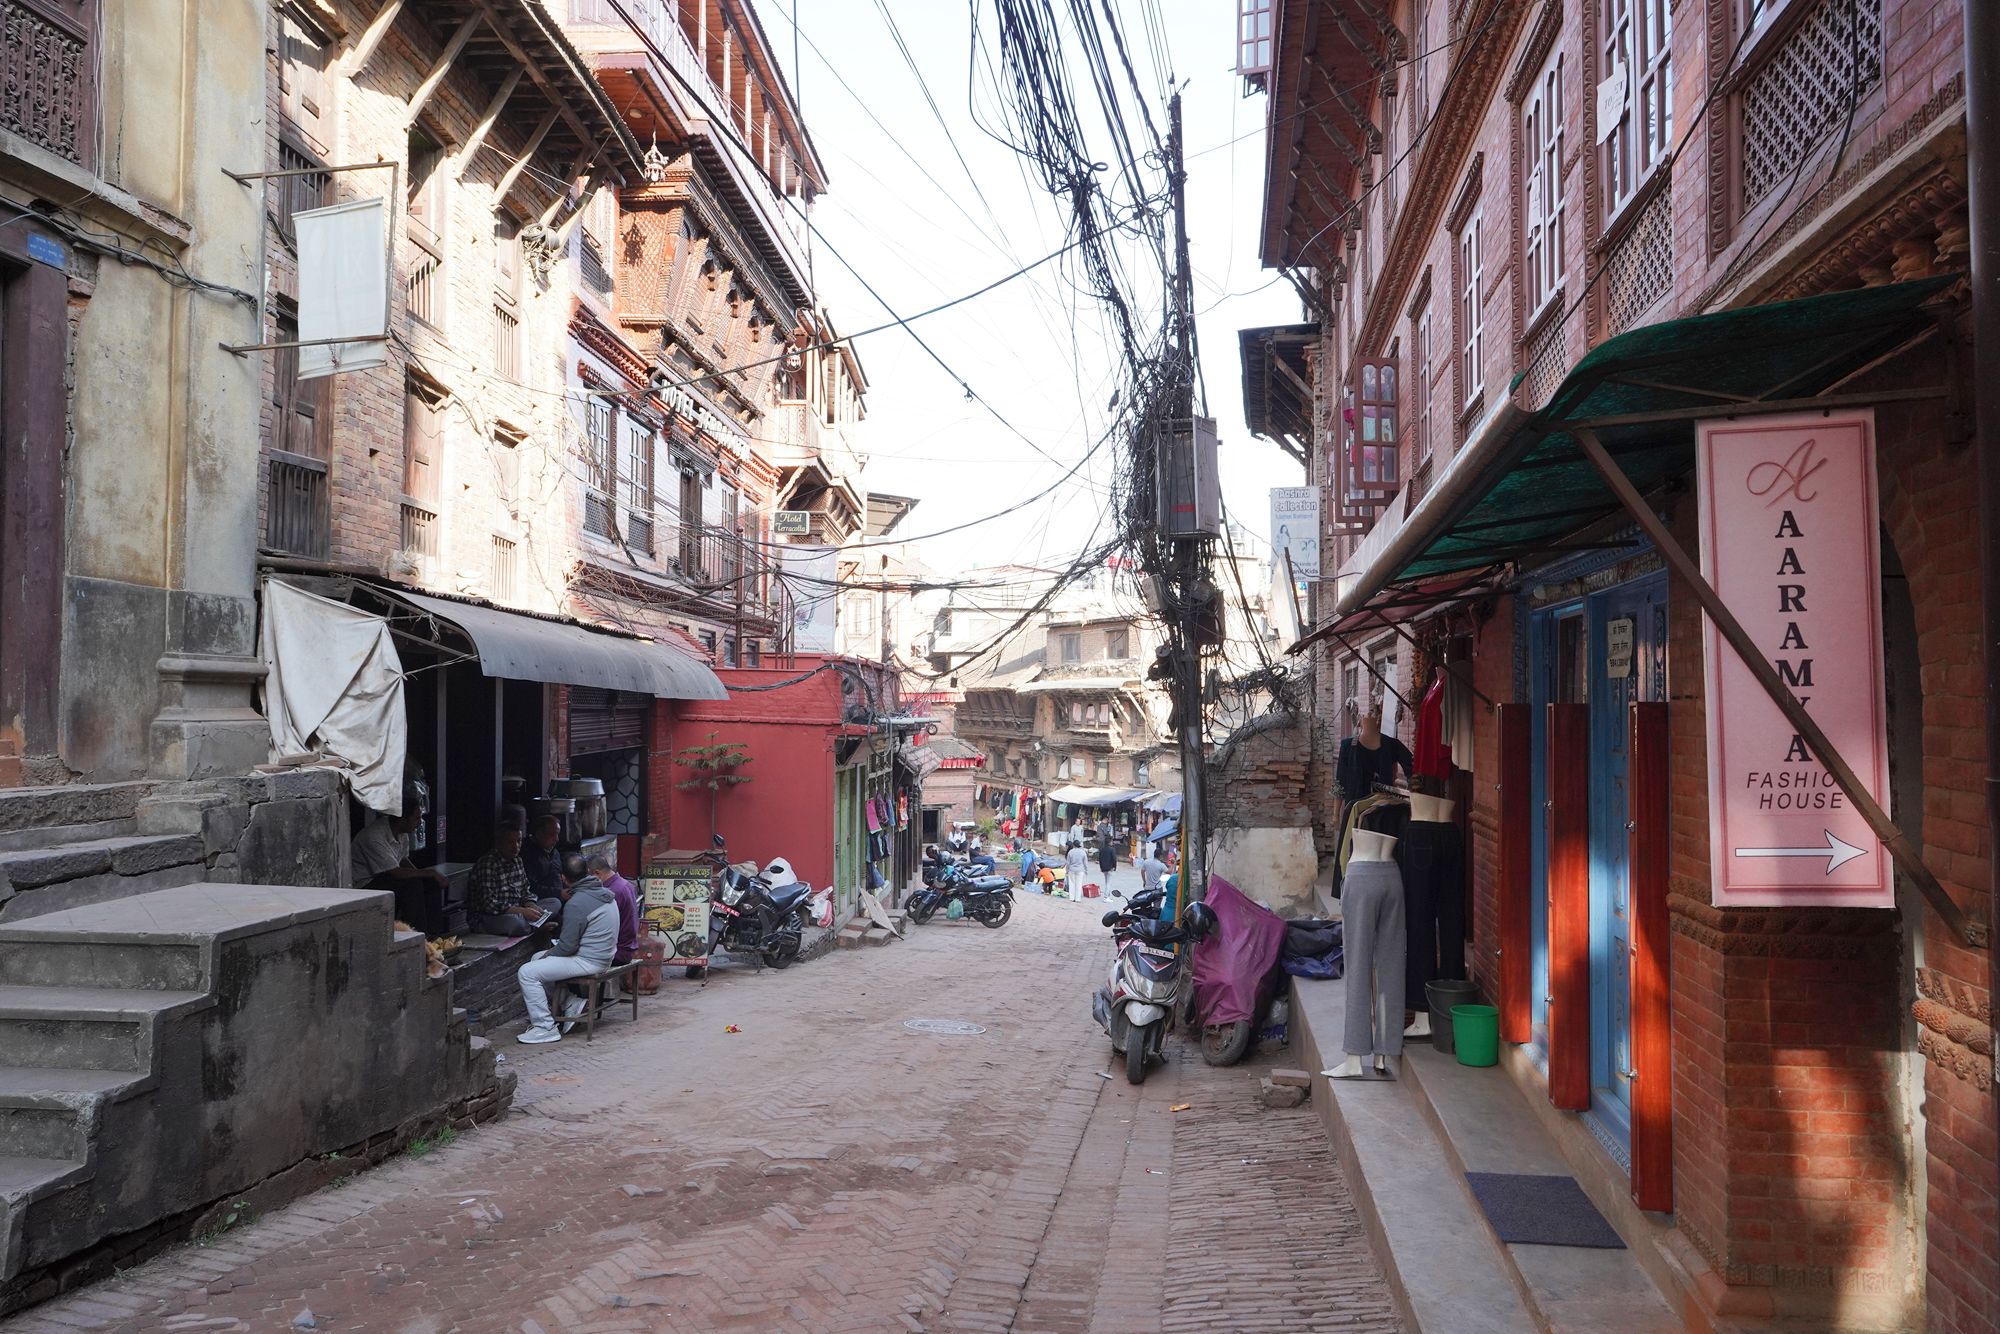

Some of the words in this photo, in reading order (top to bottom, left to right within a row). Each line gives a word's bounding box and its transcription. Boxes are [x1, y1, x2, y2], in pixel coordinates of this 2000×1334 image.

[661, 379, 694, 422] HOTEL
[779, 513, 802, 523] Hotel
[1746, 771, 1843, 790] FASHIO
[1759, 792, 1844, 810] HOUSE
